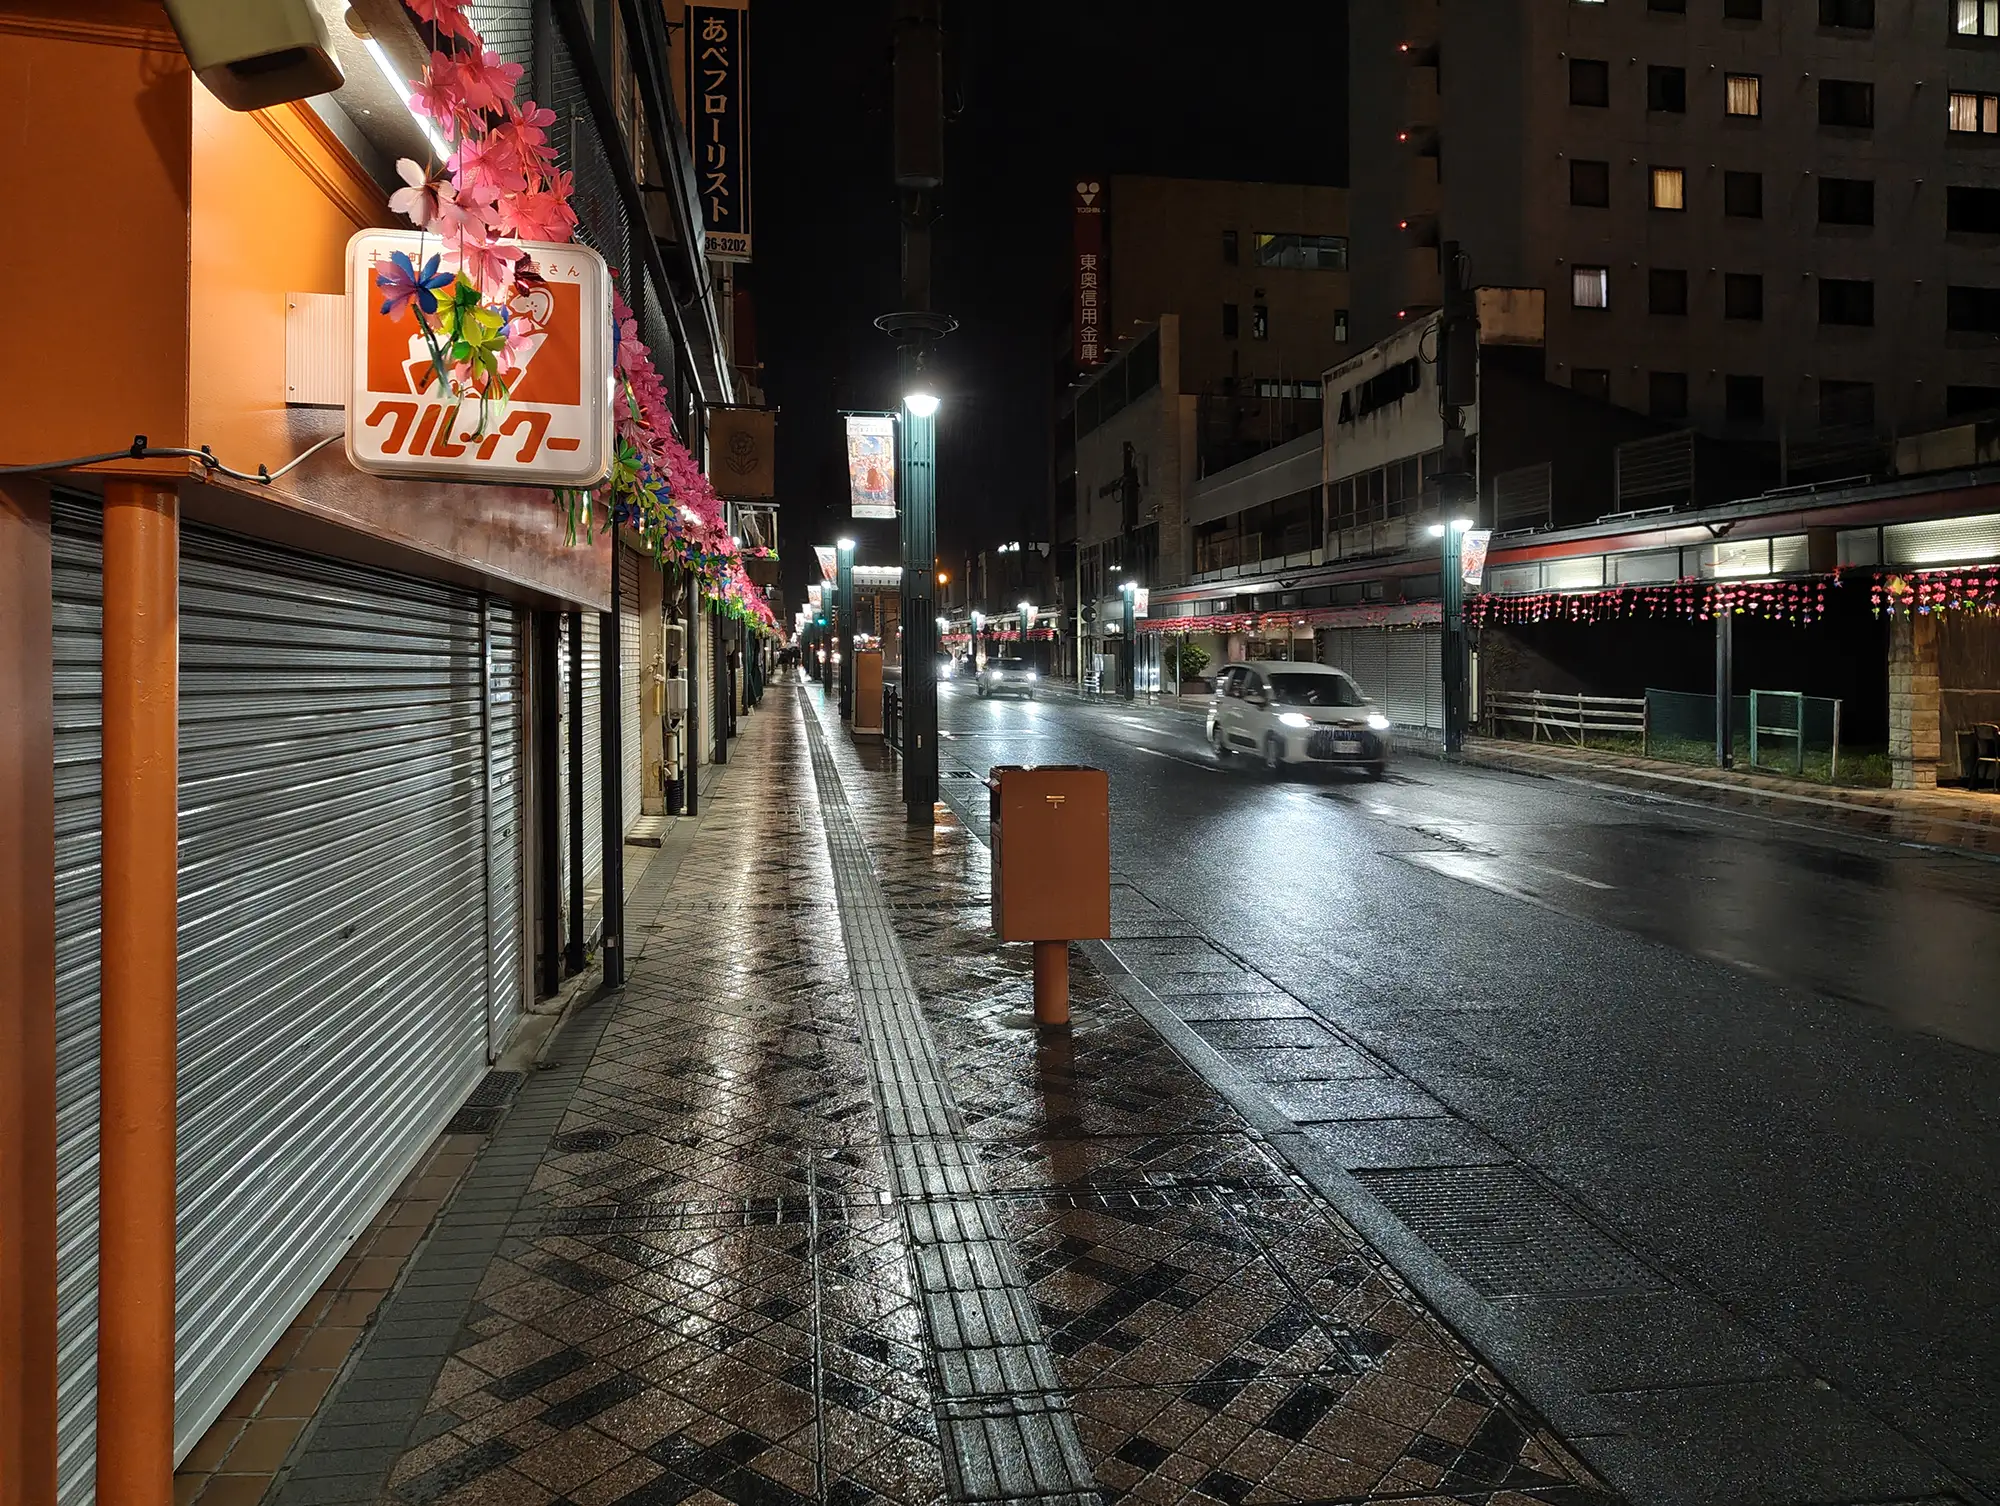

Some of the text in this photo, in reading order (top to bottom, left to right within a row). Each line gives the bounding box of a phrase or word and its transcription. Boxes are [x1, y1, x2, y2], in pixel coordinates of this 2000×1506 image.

[702, 17, 729, 222] あべフローリスト
[368, 249, 421, 266] 土町
[705, 236, 747, 252] 36-3202
[1080, 254, 1098, 360] 東奥信用金庫
[365, 401, 581, 463] クルックー
